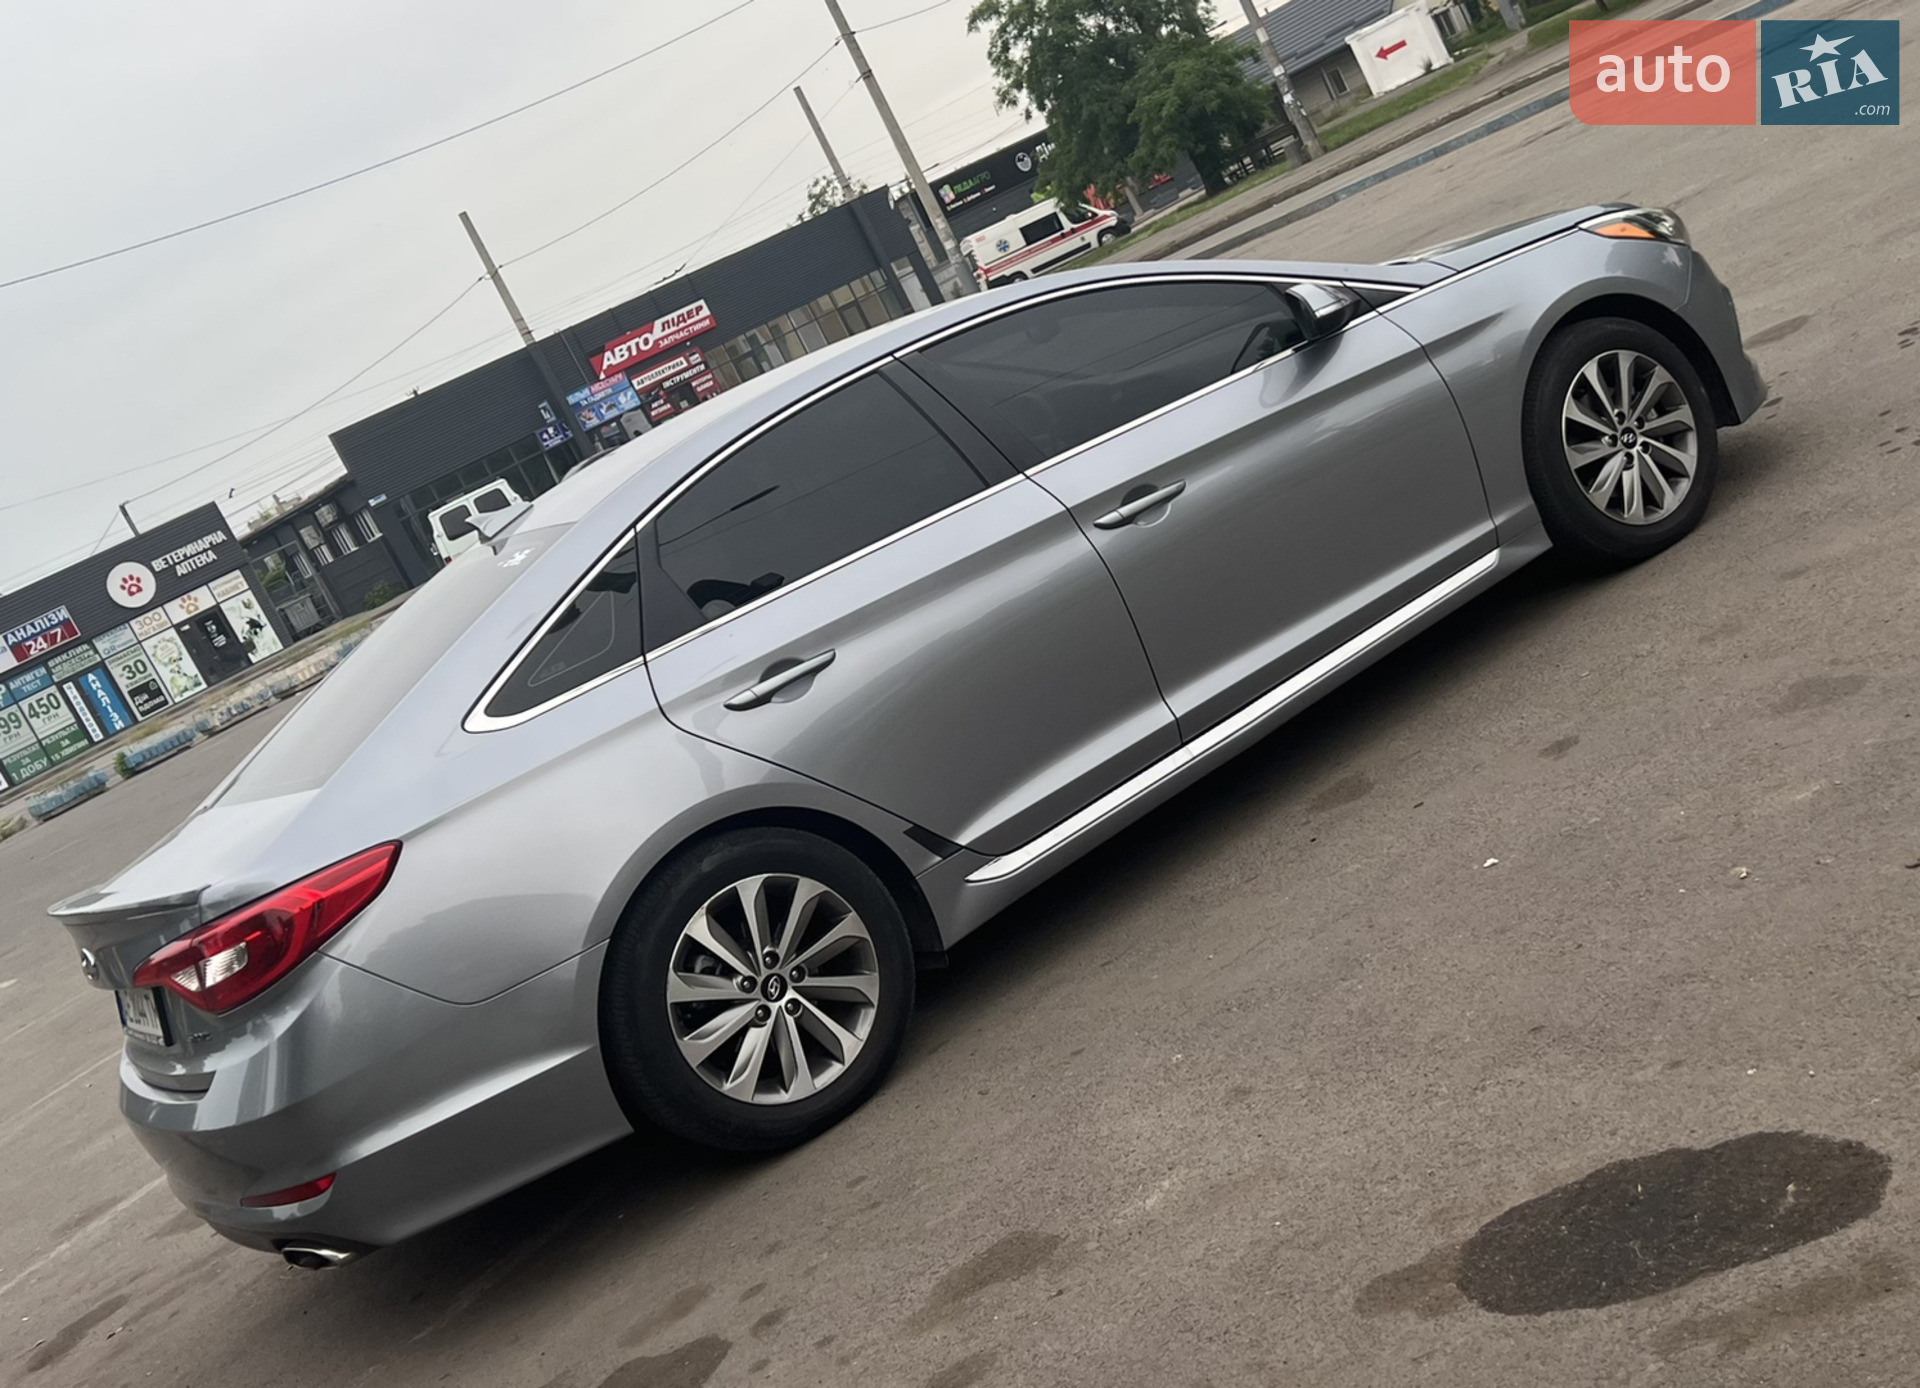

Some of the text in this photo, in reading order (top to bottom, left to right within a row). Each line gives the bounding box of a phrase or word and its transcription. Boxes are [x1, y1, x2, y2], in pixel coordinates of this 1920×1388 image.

[602, 304, 704, 371] АВТО ЛІДЕР
[658, 318, 711, 348] ЗАПЧАСТИНИ
[636, 360, 684, 387] АВТОЕЛЕКТРИКА
[662, 363, 706, 389] ІНСТРУМЕНТИ
[150, 530, 228, 572] ВЕТЕРИНАРНА
[175, 549, 218, 577] АПТЕКА
[7, 608, 68, 646] АНАЛІЗИ
[25, 627, 62, 656] 24/7
[47, 643, 91, 668] ВИКЛИК
[8, 666, 47, 691] АНТИГЕН
[121, 658, 148, 680] 30
[22, 679, 42, 693] ТЕСТ
[27, 692, 62, 720] 450
[87, 672, 125, 731] АНАЛІЗИ
[42, 712, 60, 725] ГРН
[3, 731, 21, 744] ГРН
[41, 723, 79, 747] РЕЗУЛЬТАТ
[19, 756, 48, 779] ДОБУ
